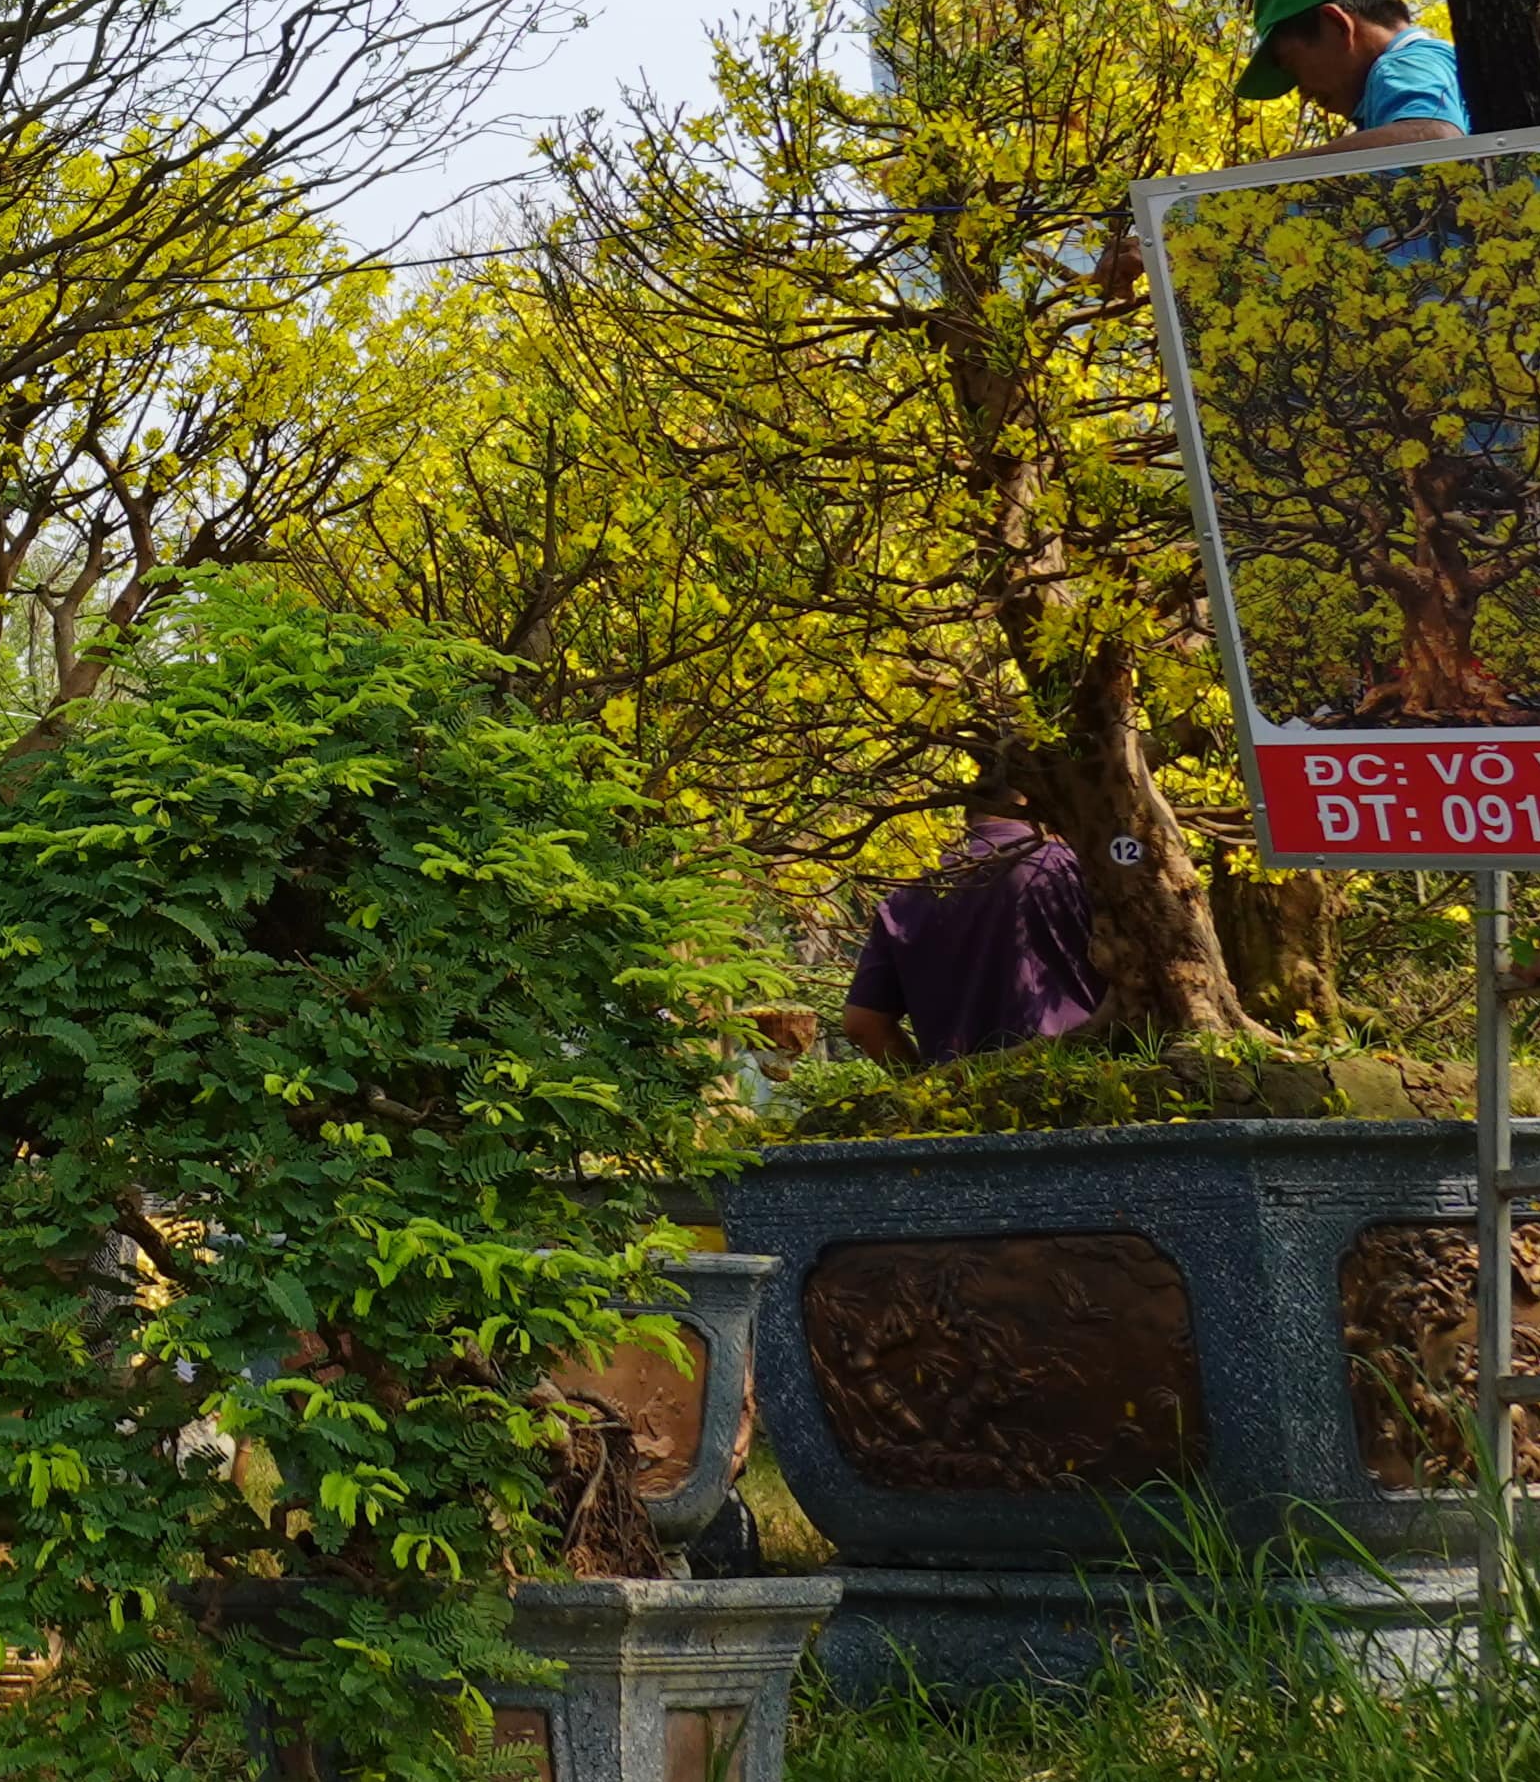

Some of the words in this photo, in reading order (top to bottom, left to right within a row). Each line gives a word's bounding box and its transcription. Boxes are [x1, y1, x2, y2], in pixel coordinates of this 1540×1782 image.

[1304, 753, 1409, 786] ĐC:
[1426, 745, 1514, 785] VÕ
[1316, 794, 1422, 842] ĐT:
[1113, 841, 1138, 860] 12
